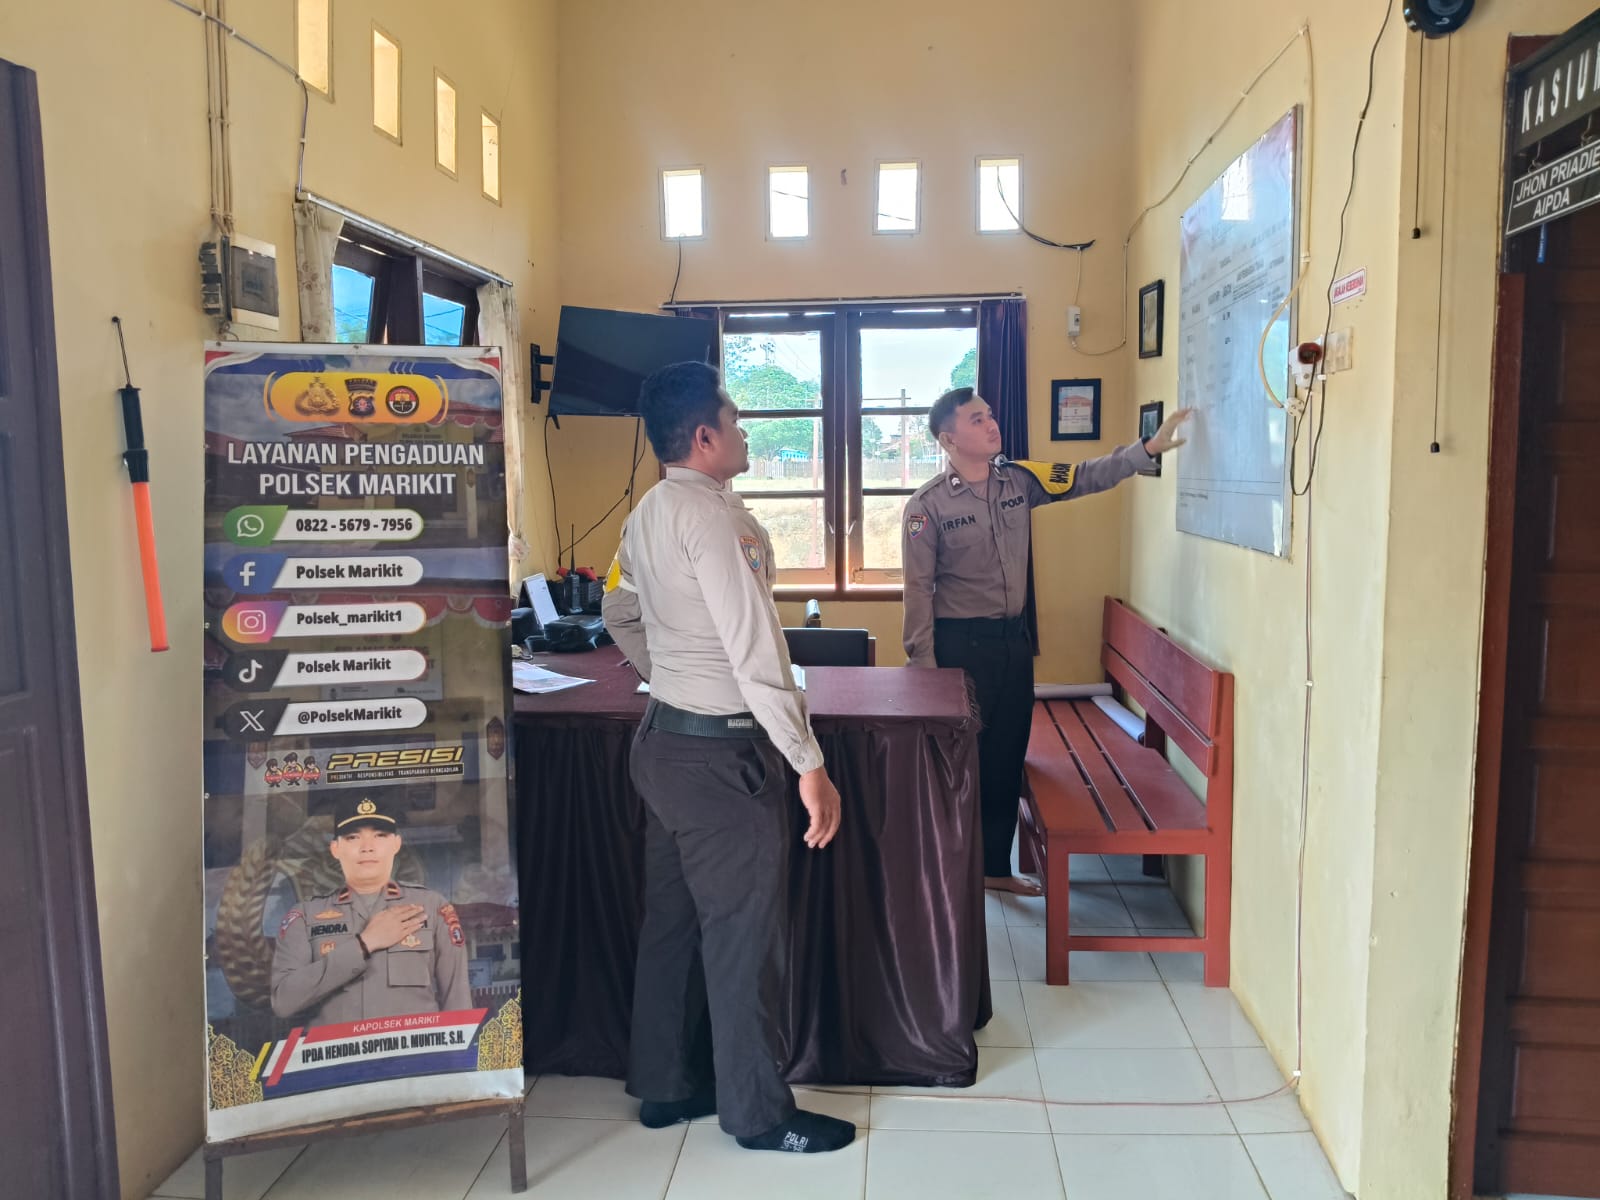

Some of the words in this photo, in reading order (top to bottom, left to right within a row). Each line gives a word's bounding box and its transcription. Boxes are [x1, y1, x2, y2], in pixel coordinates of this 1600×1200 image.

[1516, 175, 1549, 203] JHON
[1532, 187, 1570, 219] AIPDA
[228, 443, 337, 465] LAYANAN
[345, 442, 484, 465] PENGADUAN
[260, 473, 352, 495] POLSEK
[359, 473, 456, 495] MARIKIT
[1001, 495, 1025, 510] POLRI
[296, 518, 328, 532] 0822
[339, 518, 371, 532] 5679
[381, 518, 413, 532] 7956
[942, 514, 976, 531] IRFAN
[296, 564, 345, 580] Polsek
[348, 563, 403, 578] Marikit
[296, 609, 402, 626] Polsek_marikit1
[297, 660, 340, 674] Polsek
[343, 658, 392, 672] Marikit
[297, 706, 402, 725] @PolsekMarikit
[327, 746, 464, 770] PRESISI
[311, 923, 348, 937] HENDRA
[353, 1018, 402, 1033] KAPOLSEK
[403, 1015, 441, 1029] MARIKIT
[301, 1047, 323, 1064] IPDA
[324, 1042, 360, 1061] HENDRA
[361, 1038, 399, 1057] SOPIYAN
[410, 1032, 447, 1050] MUNTHE,
[448, 1030, 466, 1047] S.H.
[784, 1131, 809, 1146] POLRI
